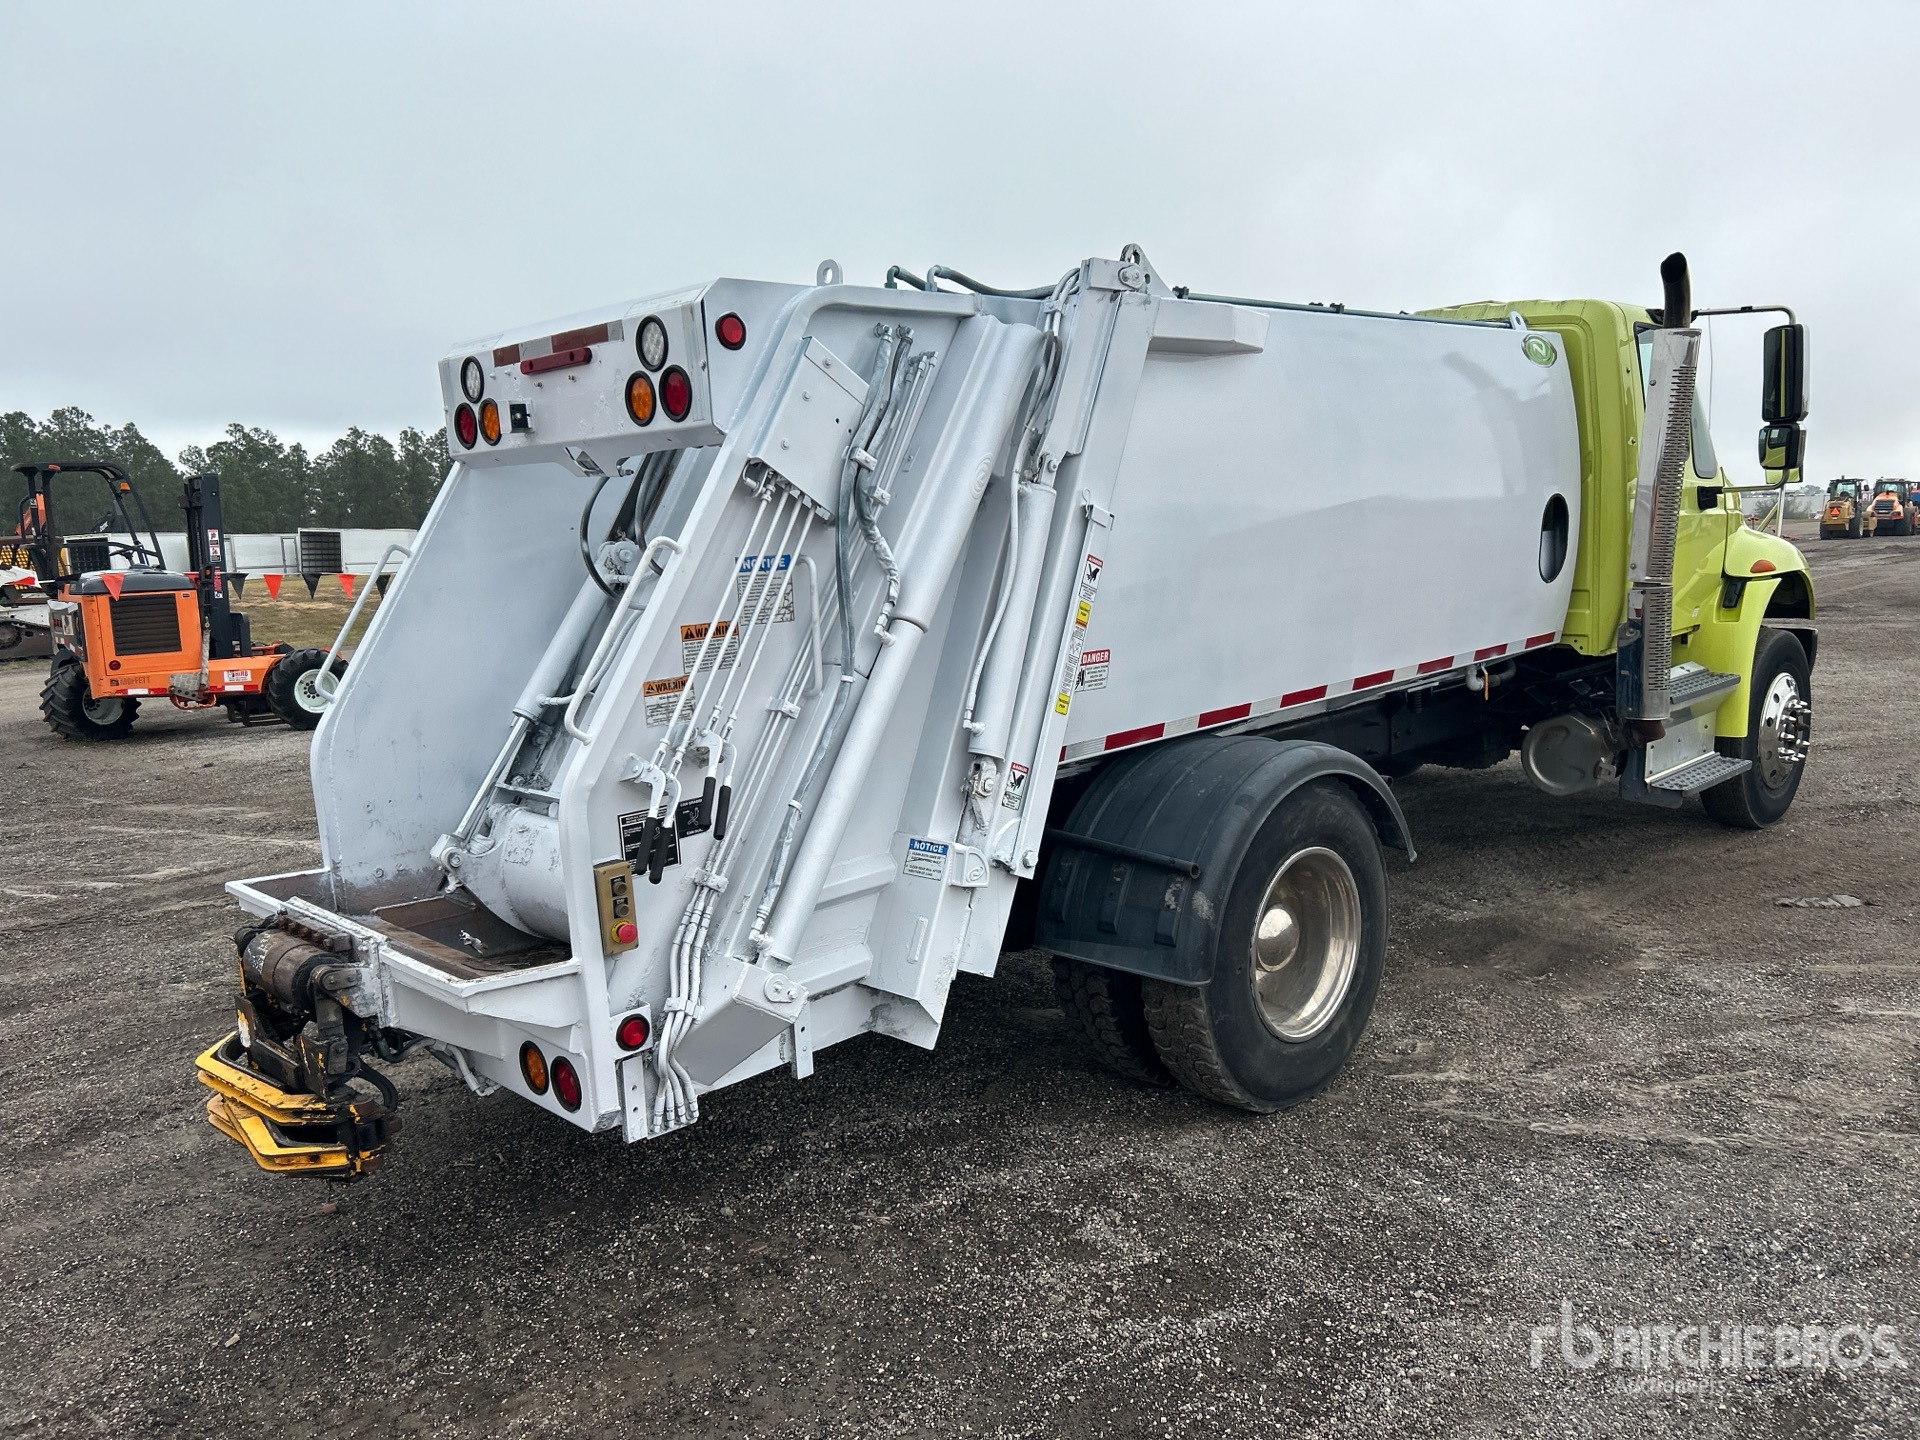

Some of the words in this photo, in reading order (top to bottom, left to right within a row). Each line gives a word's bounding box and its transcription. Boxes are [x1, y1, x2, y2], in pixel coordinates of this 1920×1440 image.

[1082, 651, 1109, 664] DANGER
[655, 679, 690, 693] WARNIN
[913, 841, 945, 853] NOTICE
